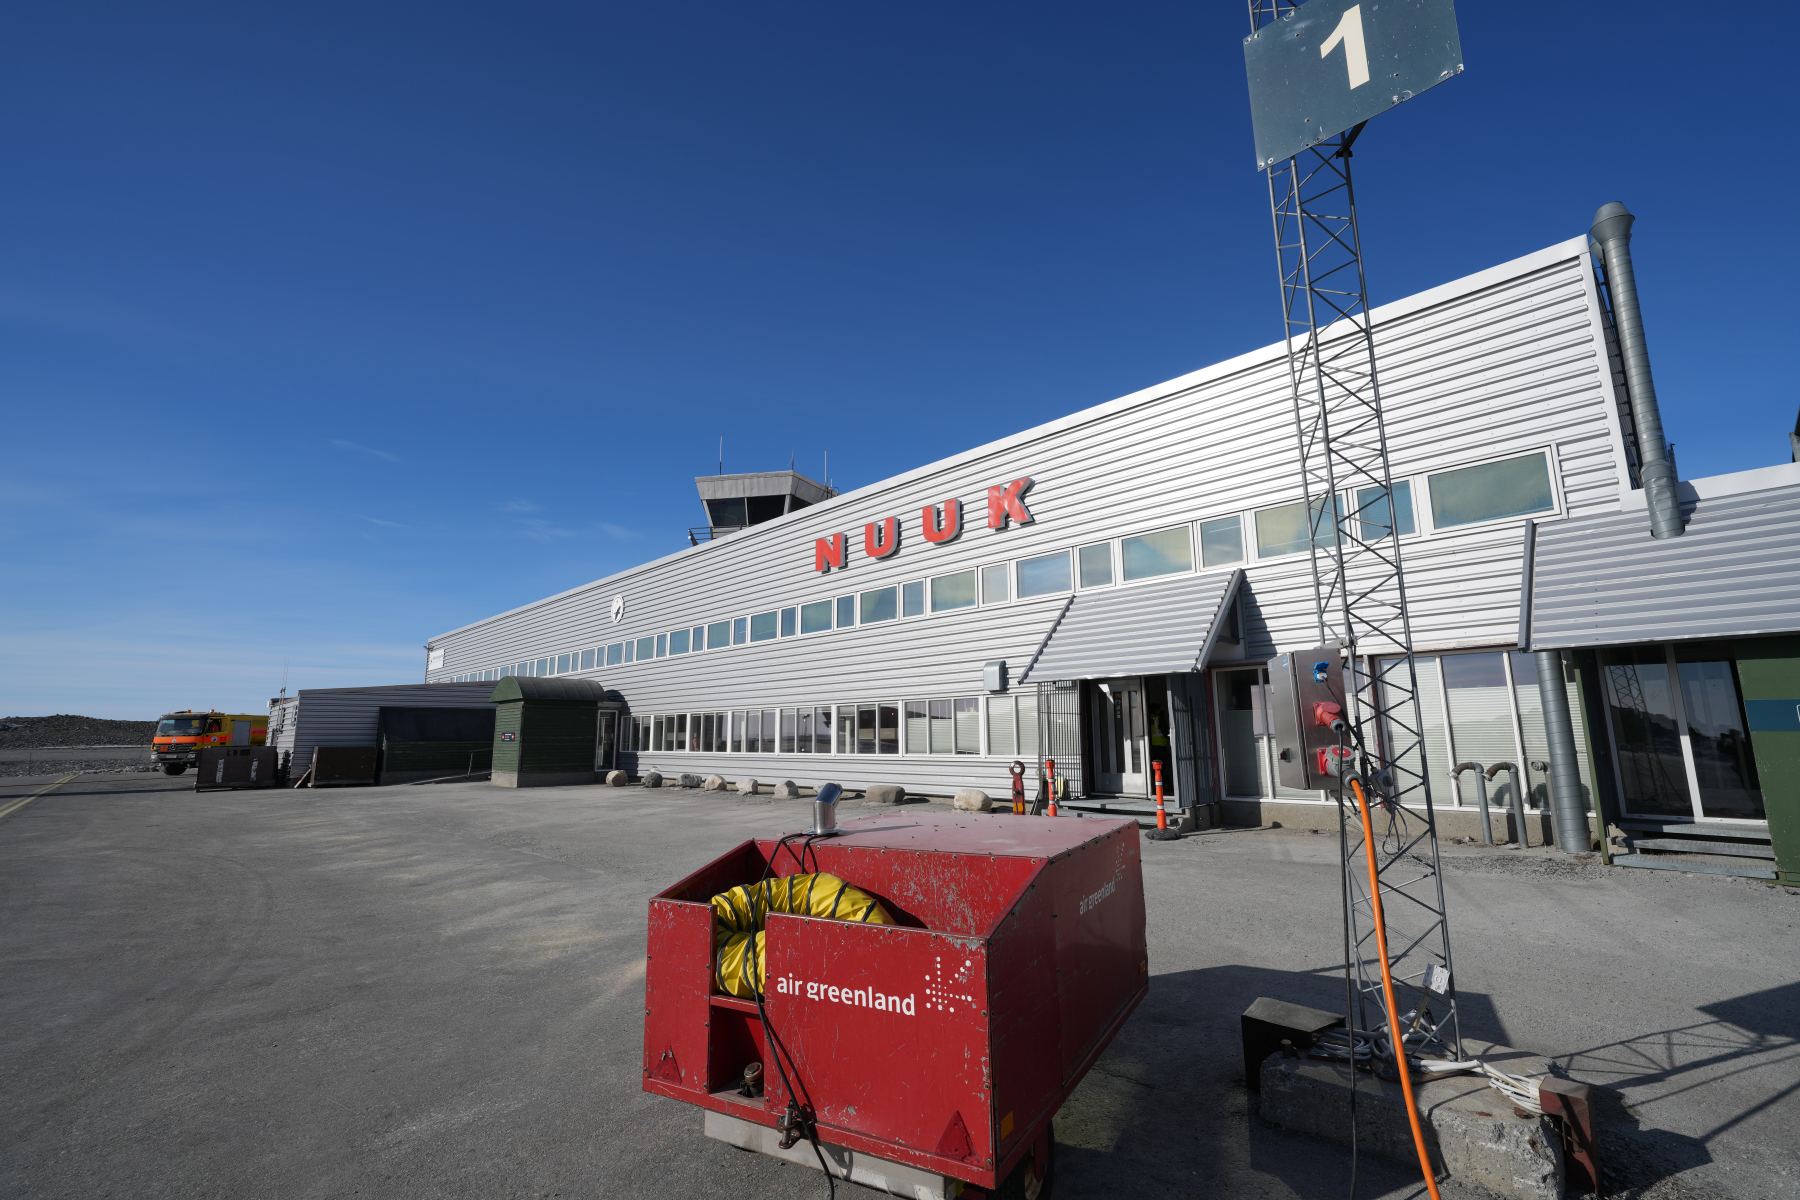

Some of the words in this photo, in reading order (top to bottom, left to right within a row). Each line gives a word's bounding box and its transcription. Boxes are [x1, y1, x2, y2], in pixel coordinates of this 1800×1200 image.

[1319, 3, 1370, 90] 1
[815, 476, 1034, 574] NUUK
[776, 972, 803, 996] air
[806, 981, 916, 1016] greenland
